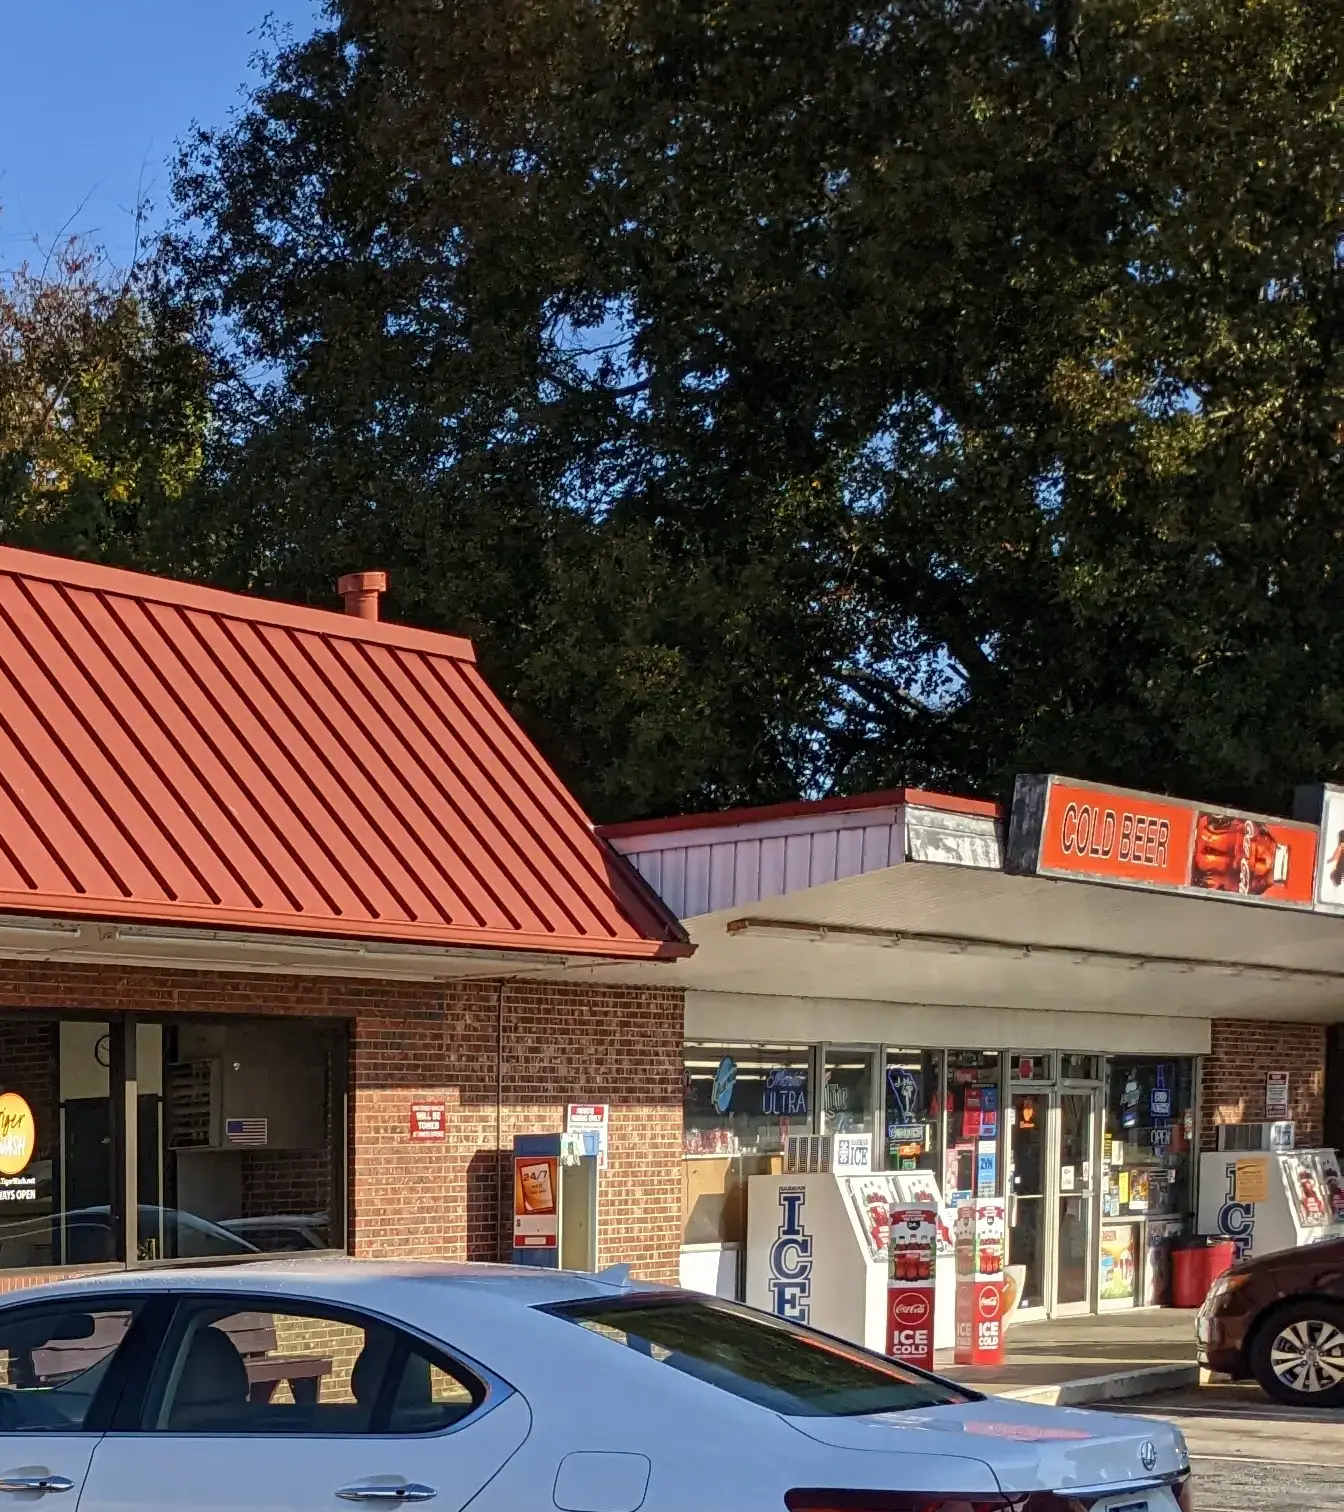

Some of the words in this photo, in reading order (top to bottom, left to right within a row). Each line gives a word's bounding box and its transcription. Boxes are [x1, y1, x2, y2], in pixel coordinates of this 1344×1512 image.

[1061, 802, 1115, 858] COLD
[1118, 812, 1170, 867] BEER
[762, 1090, 806, 1114] ULTRA
[850, 1147, 869, 1166] ICE
[523, 1170, 548, 1181] 24/7
[16, 1189, 36, 1200] OPEN
[769, 1192, 813, 1326] ICE
[978, 1321, 999, 1336] ICE
[893, 1330, 928, 1344] ICE
[978, 1336, 999, 1346] COLD
[892, 1345, 928, 1354] COLD
